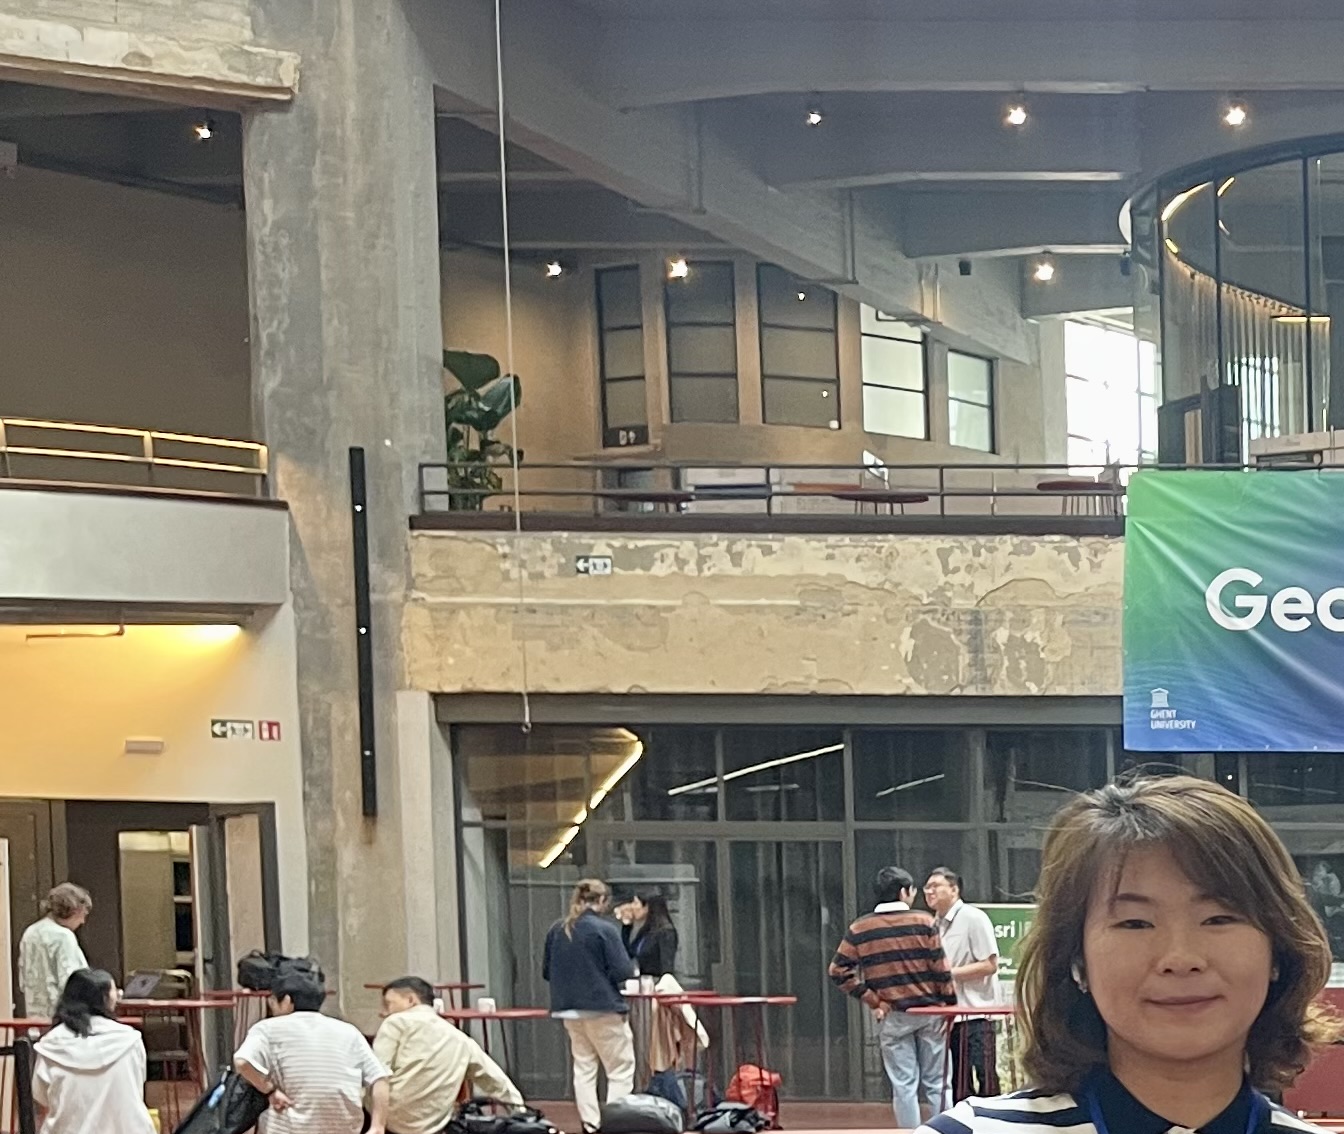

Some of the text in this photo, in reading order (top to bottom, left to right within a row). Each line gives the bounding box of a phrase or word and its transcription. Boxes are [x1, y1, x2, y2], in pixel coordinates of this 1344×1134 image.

[1151, 709, 1176, 718] GHENT
[1151, 720, 1196, 729] UNIVERSITY
[994, 920, 1015, 938] sri
